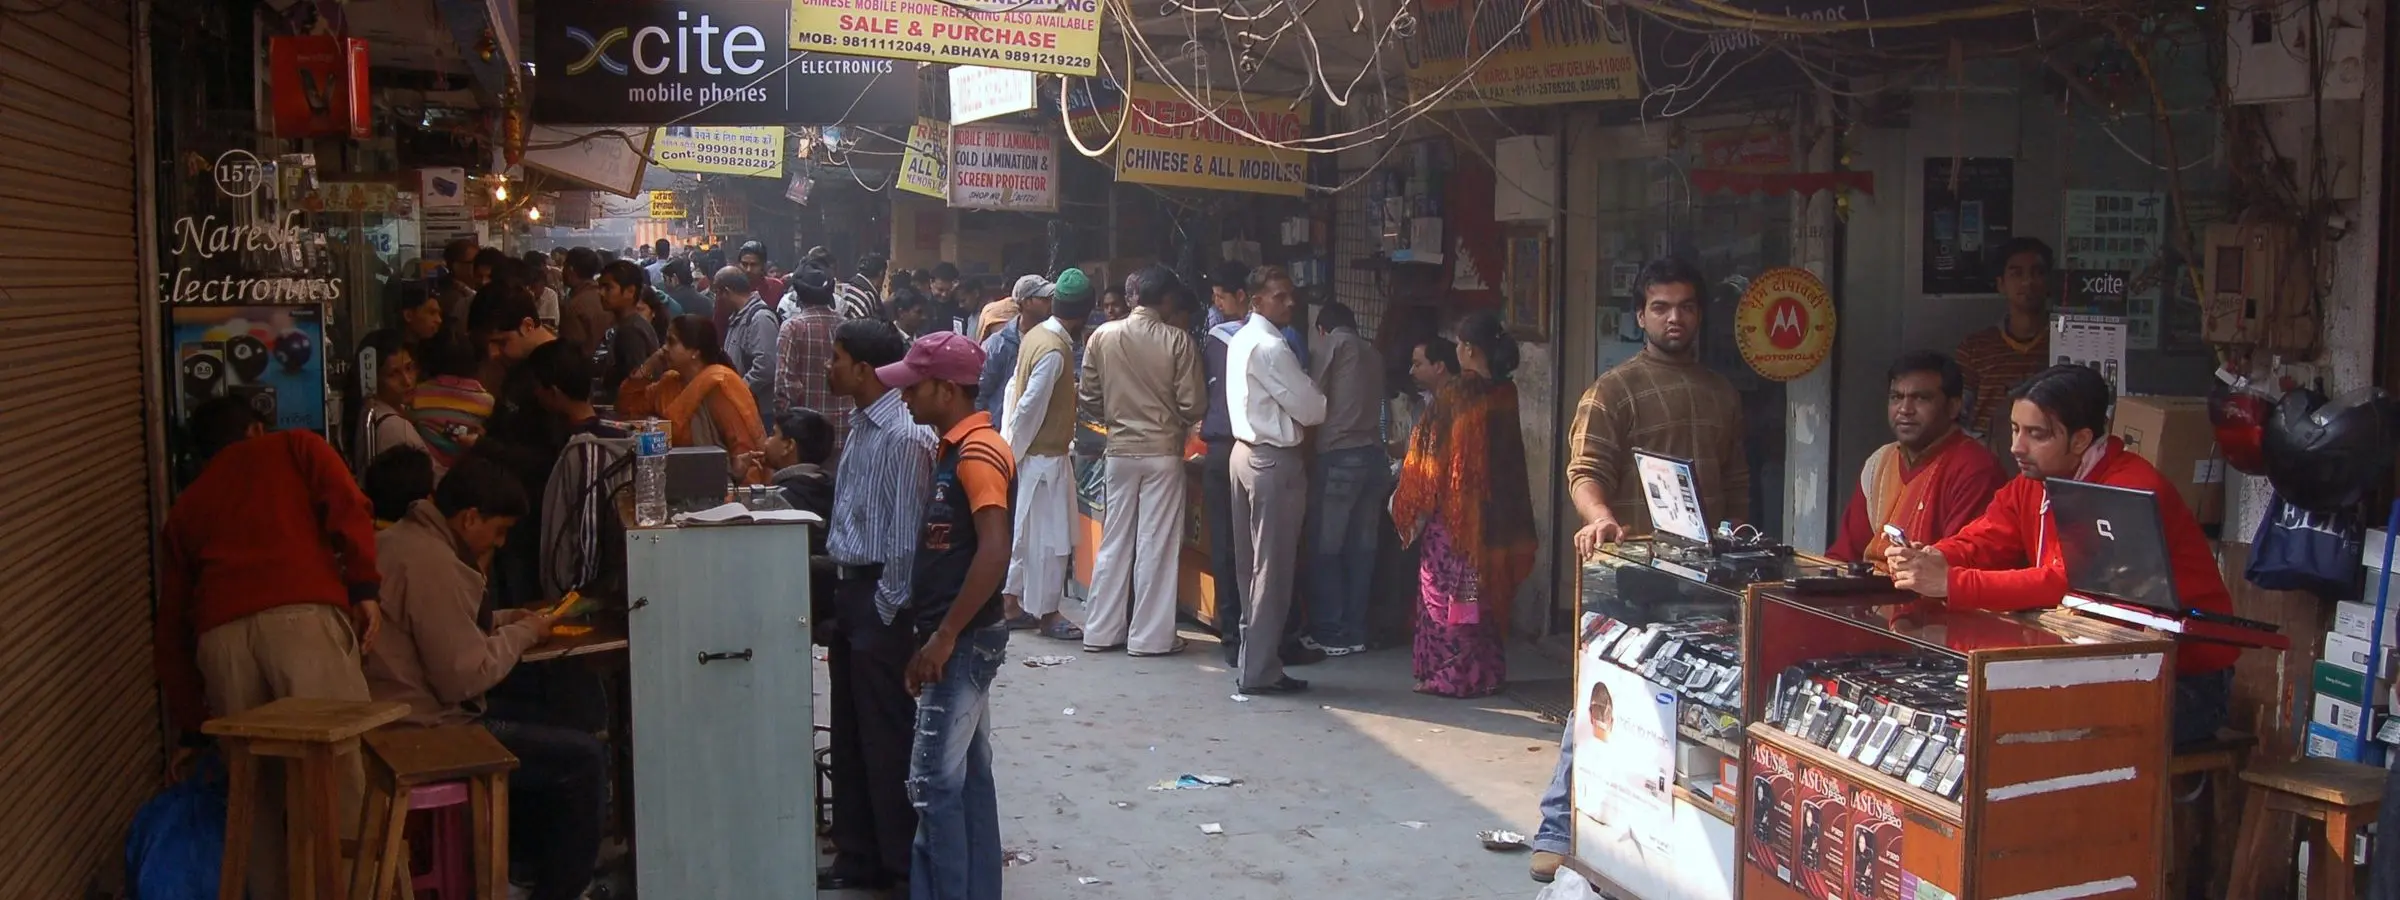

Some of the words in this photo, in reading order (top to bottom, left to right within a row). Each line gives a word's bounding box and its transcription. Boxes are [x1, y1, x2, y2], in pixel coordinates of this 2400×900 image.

[854, 0, 897, 13] MOBILE
[900, 2, 937, 17] PHONE
[941, 7, 1000, 22] REPAIRING
[1004, 12, 1032, 25] ALSO
[1035, 15, 1095, 31] AVAILABLE
[839, 15, 899, 35] SALE
[908, 21, 923, 36] &
[932, 23, 1057, 49] PURCHASE
[799, 32, 837, 47] MOB:
[842, 36, 935, 56] 9811112049,
[940, 45, 1000, 60] ABHAYA
[1005, 50, 1091, 69] 9891219229
[801, 59, 894, 75] ELECTRONICS
[629, 82, 694, 103] mobile
[700, 82, 767, 107] phones
[1131, 97, 1301, 148] REPAIRING
[661, 149, 695, 161] Cont:
[697, 143, 776, 158] 9999818181
[954, 131, 982, 147] MOBILE
[985, 132, 1001, 148] HOT
[1002, 133, 1050, 151] LAMINATION
[220, 165, 256, 183] 157
[697, 155, 776, 170] 9999828282
[908, 157, 932, 177] ALL
[955, 151, 978, 167] COLD
[981, 152, 1038, 171] LAMINATION
[1040, 157, 1048, 171] &
[1125, 147, 1189, 174] CHINESE
[1193, 156, 1203, 174] &
[1208, 157, 1235, 178] ALL
[1239, 160, 1302, 183] MOBILES
[957, 171, 993, 188] SCREEN
[995, 173, 1047, 192] PROTECTOR
[171, 209, 301, 260] Naresh
[159, 267, 342, 304] Electronics
[2081, 272, 2123, 294] xcite
[1754, 351, 1815, 363] MOTOROLA
[363, 352, 373, 393] PULL
[1752, 743, 1779, 772] ASUS
[1799, 767, 1830, 797] ASUS
[1850, 791, 1882, 820] ASUS
